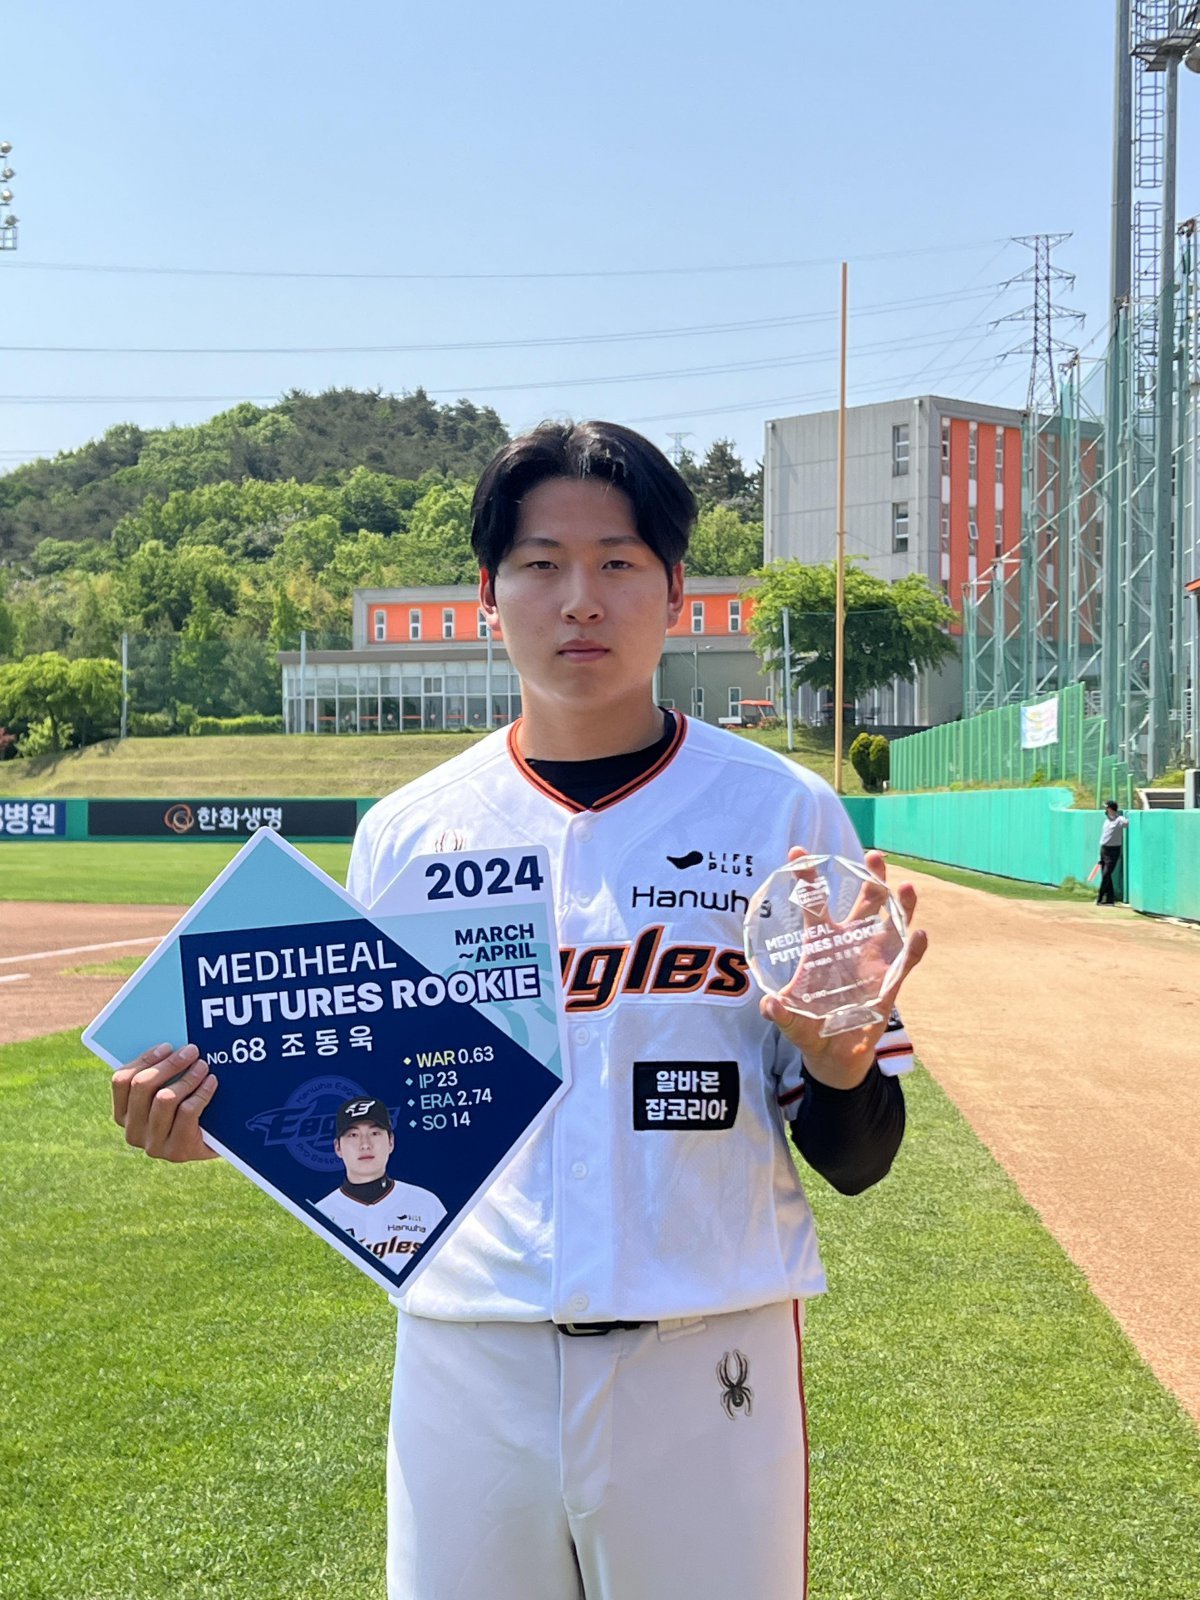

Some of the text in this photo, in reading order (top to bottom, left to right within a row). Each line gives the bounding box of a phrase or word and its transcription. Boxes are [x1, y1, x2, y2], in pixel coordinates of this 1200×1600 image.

[0, 803, 55, 834] 병원
[197, 806, 282, 831] 한화생명
[708, 862, 753, 877] PLUS
[709, 851, 753, 865] LIFE
[425, 855, 544, 900] 2024
[455, 923, 534, 946] MARCH
[765, 923, 835, 952] MEDIHEAL
[769, 938, 833, 966] FUTURES
[833, 921, 886, 947] ROOKIE
[198, 940, 397, 987] MEDIHEAL
[459, 942, 537, 963] ~APRIL
[559, 924, 751, 1013] gles
[202, 965, 540, 1028] FUTURES ROOKIE
[207, 1037, 267, 1065] NO.68
[416, 1046, 494, 1068] WAR 0.63
[419, 1071, 458, 1089] IP 23
[656, 1070, 720, 1093] 알바몬
[421, 1088, 492, 1110] ERA 2.74
[645, 1098, 728, 1121] 잡코리아
[422, 1111, 471, 1131] SO 14
[387, 1224, 427, 1234] Hanwha
